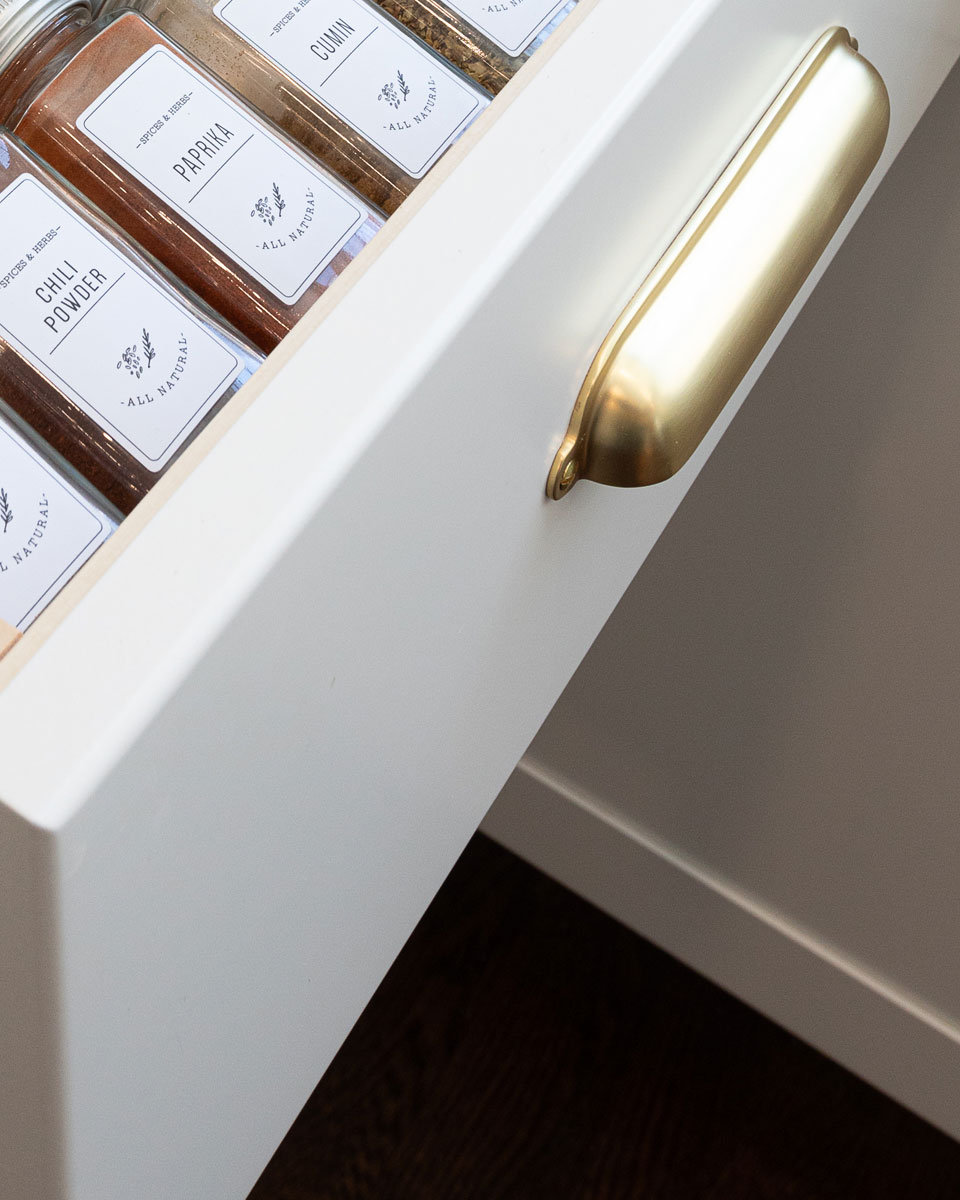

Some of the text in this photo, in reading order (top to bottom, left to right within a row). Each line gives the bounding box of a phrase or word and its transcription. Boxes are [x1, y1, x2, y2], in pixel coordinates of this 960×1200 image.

[310, 18, 355, 61] CUMIN
[162, 114, 171, 122] &
[172, 123, 234, 182] PAPRIKA
[25, 253, 35, 262] &
[35, 260, 78, 303] CHILI
[43, 268, 107, 333] POWDER
